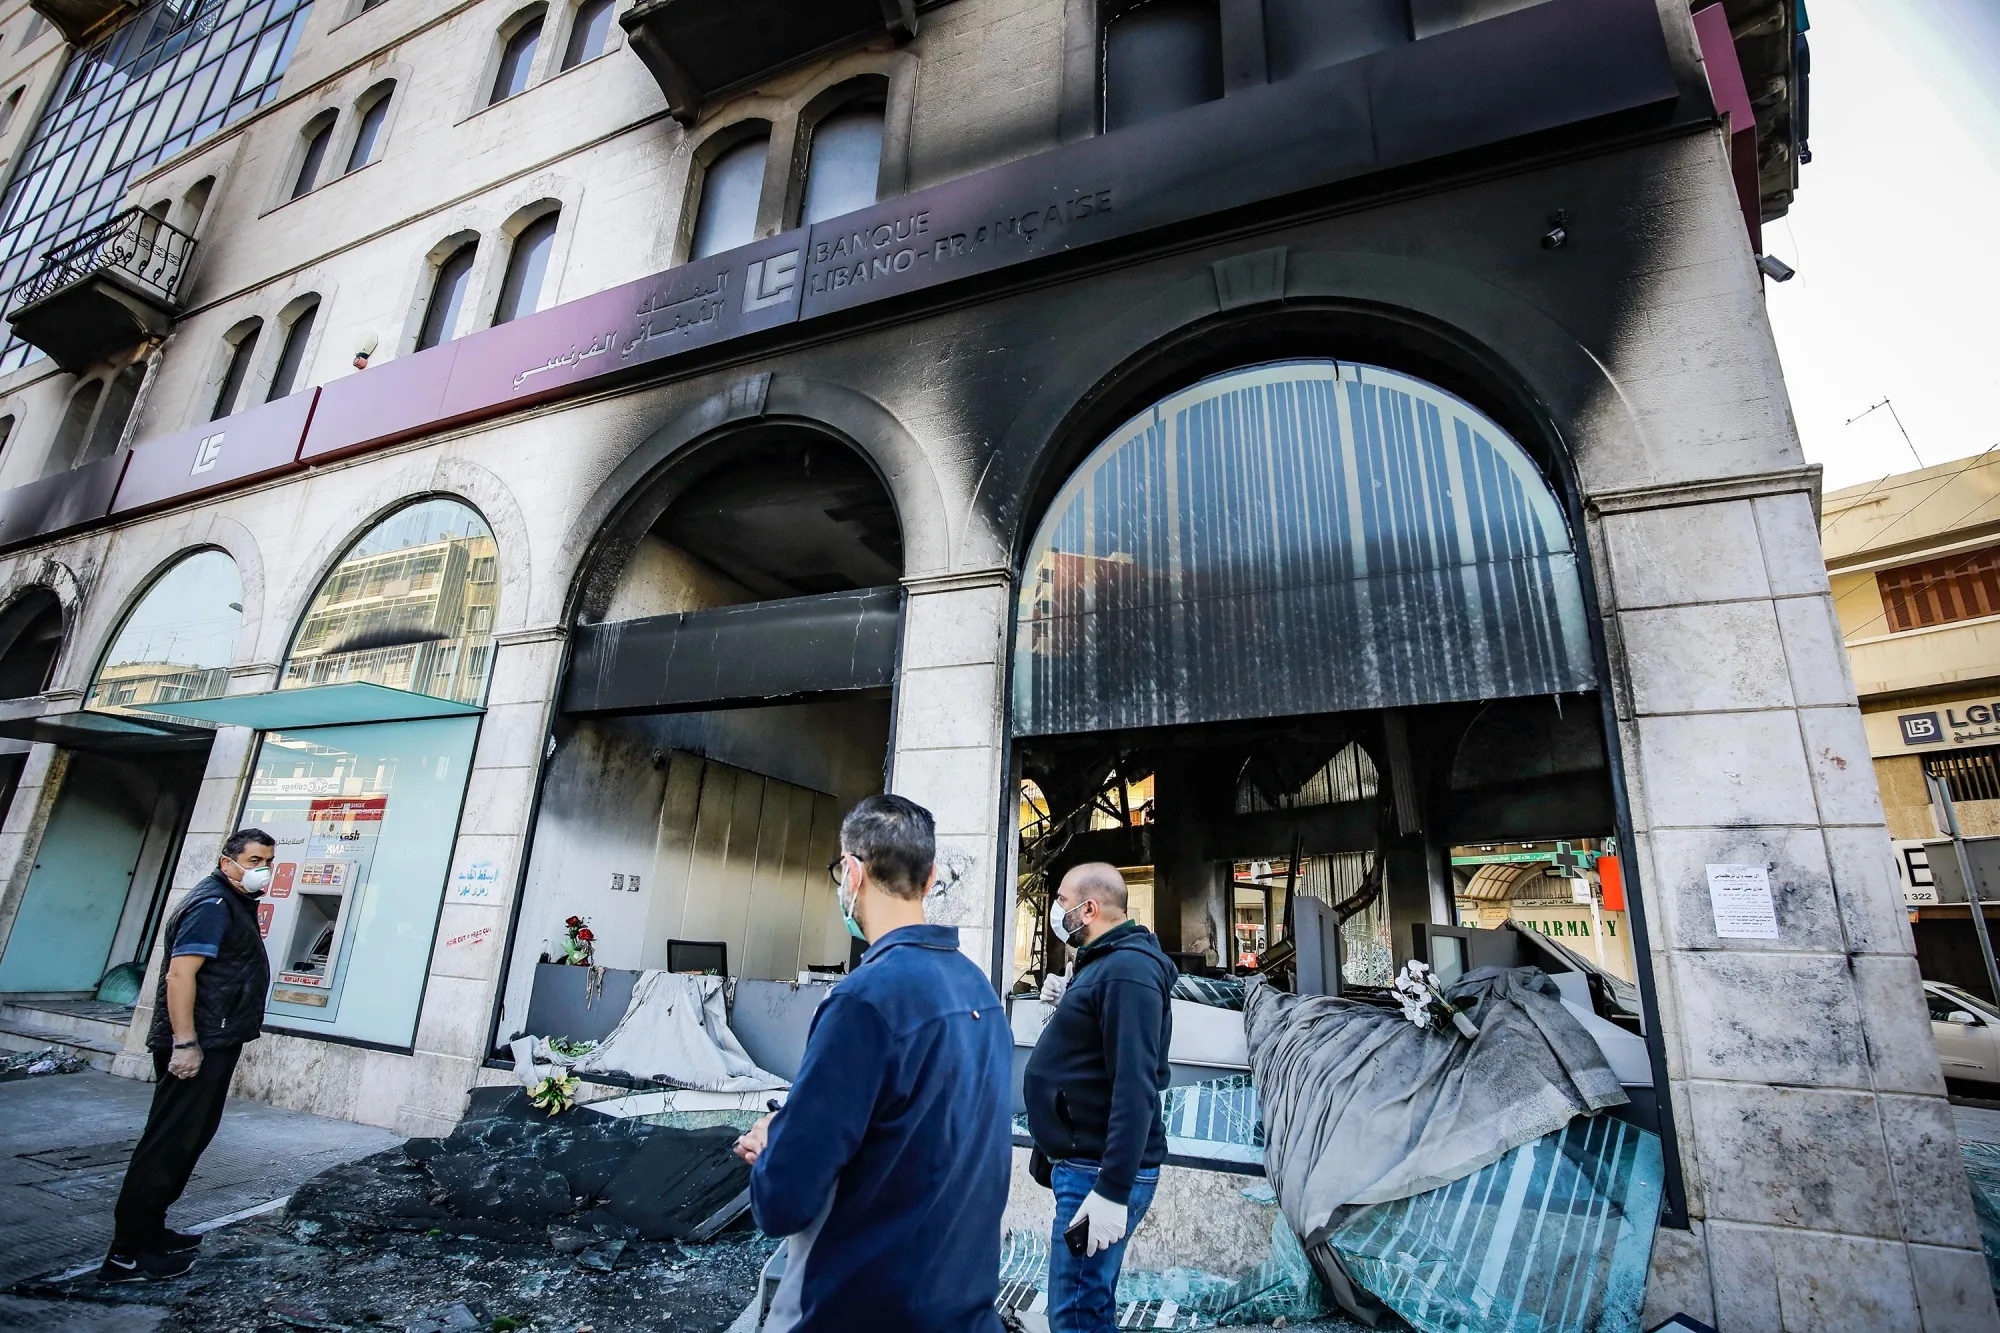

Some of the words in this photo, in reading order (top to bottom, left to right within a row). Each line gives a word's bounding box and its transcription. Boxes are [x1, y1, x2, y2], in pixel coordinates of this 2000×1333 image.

[809, 189, 1113, 296] LIBANO-FRANÇAISE
[814, 211, 930, 265] BANQUE
[636, 270, 730, 317] البنك
[621, 299, 726, 360] اللبناني
[513, 331, 618, 390] الفرنسي
[1518, 920, 1617, 937] HARMAY
